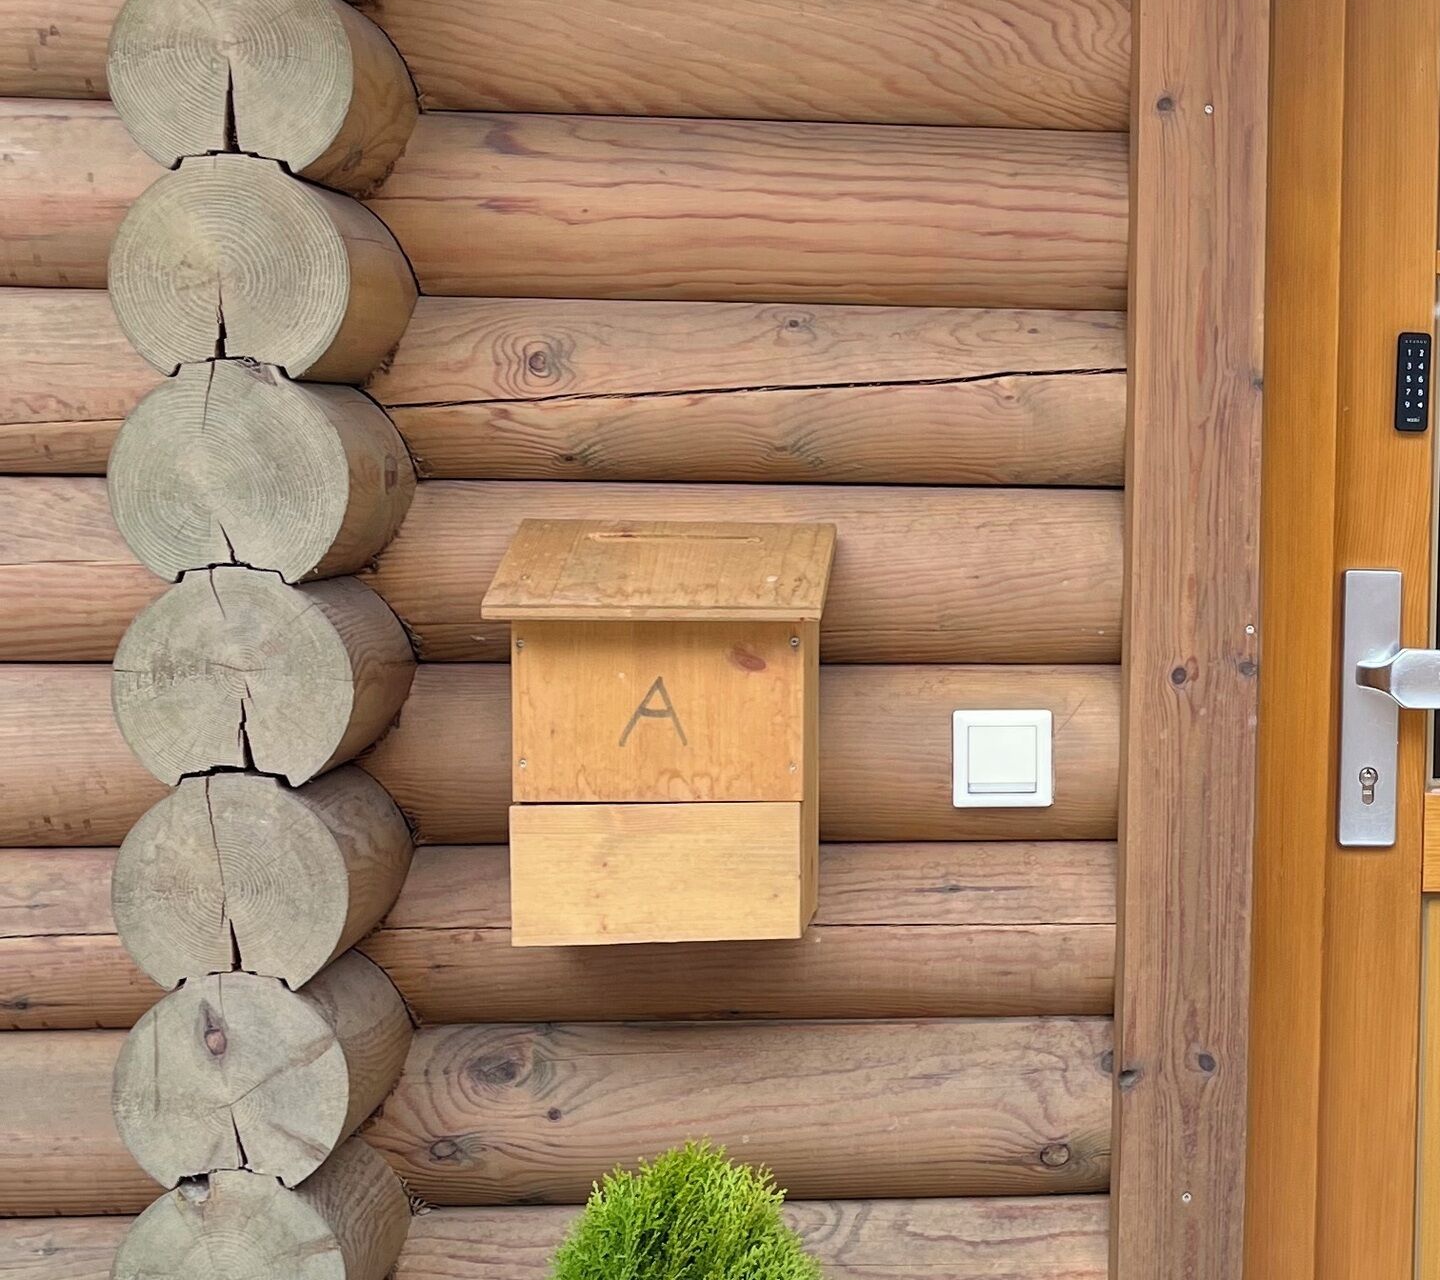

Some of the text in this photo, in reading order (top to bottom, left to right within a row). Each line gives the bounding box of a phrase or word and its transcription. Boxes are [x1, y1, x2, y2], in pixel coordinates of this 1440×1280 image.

[1407, 349, 1425, 357] 1 2
[1406, 362, 1424, 370] 3 4
[1406, 375, 1424, 383] 5 6
[1405, 387, 1424, 397] 7 8
[1404, 400, 1411, 408] 9
[618, 675, 688, 748] A
